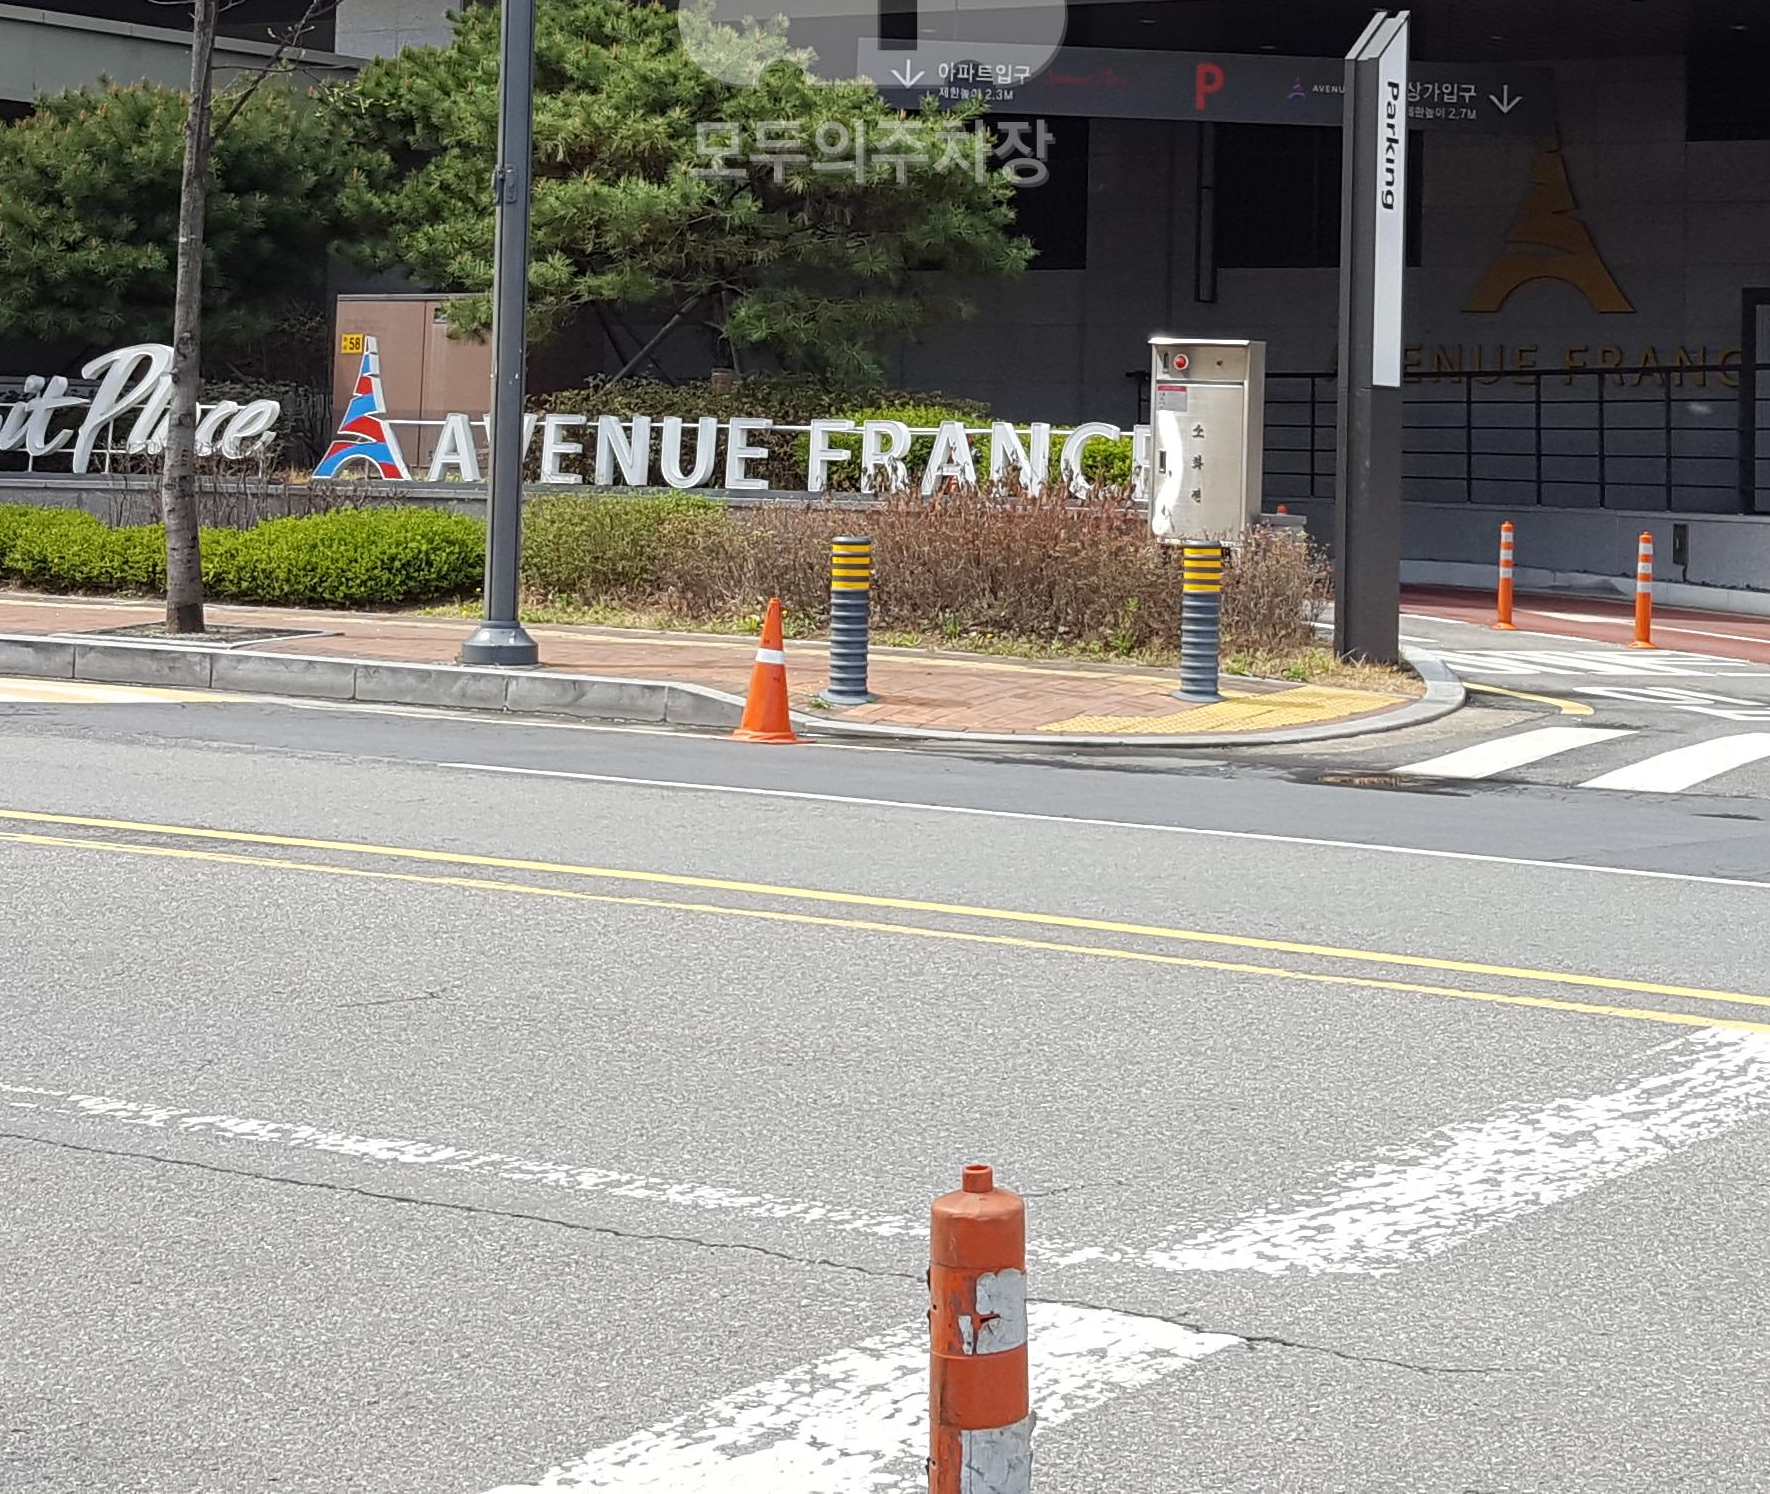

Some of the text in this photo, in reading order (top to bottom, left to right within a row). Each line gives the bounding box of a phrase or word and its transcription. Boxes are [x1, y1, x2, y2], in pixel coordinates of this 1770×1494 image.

[938, 61, 1031, 85] 아파트입구
[1195, 63, 1225, 110] P
[1312, 84, 1345, 94] AVENU
[1407, 81, 1478, 104] 상가입구
[1382, 81, 1400, 211] Parking
[349, 337, 361, 351] 58
[1561, 344, 1742, 389] FRANC
